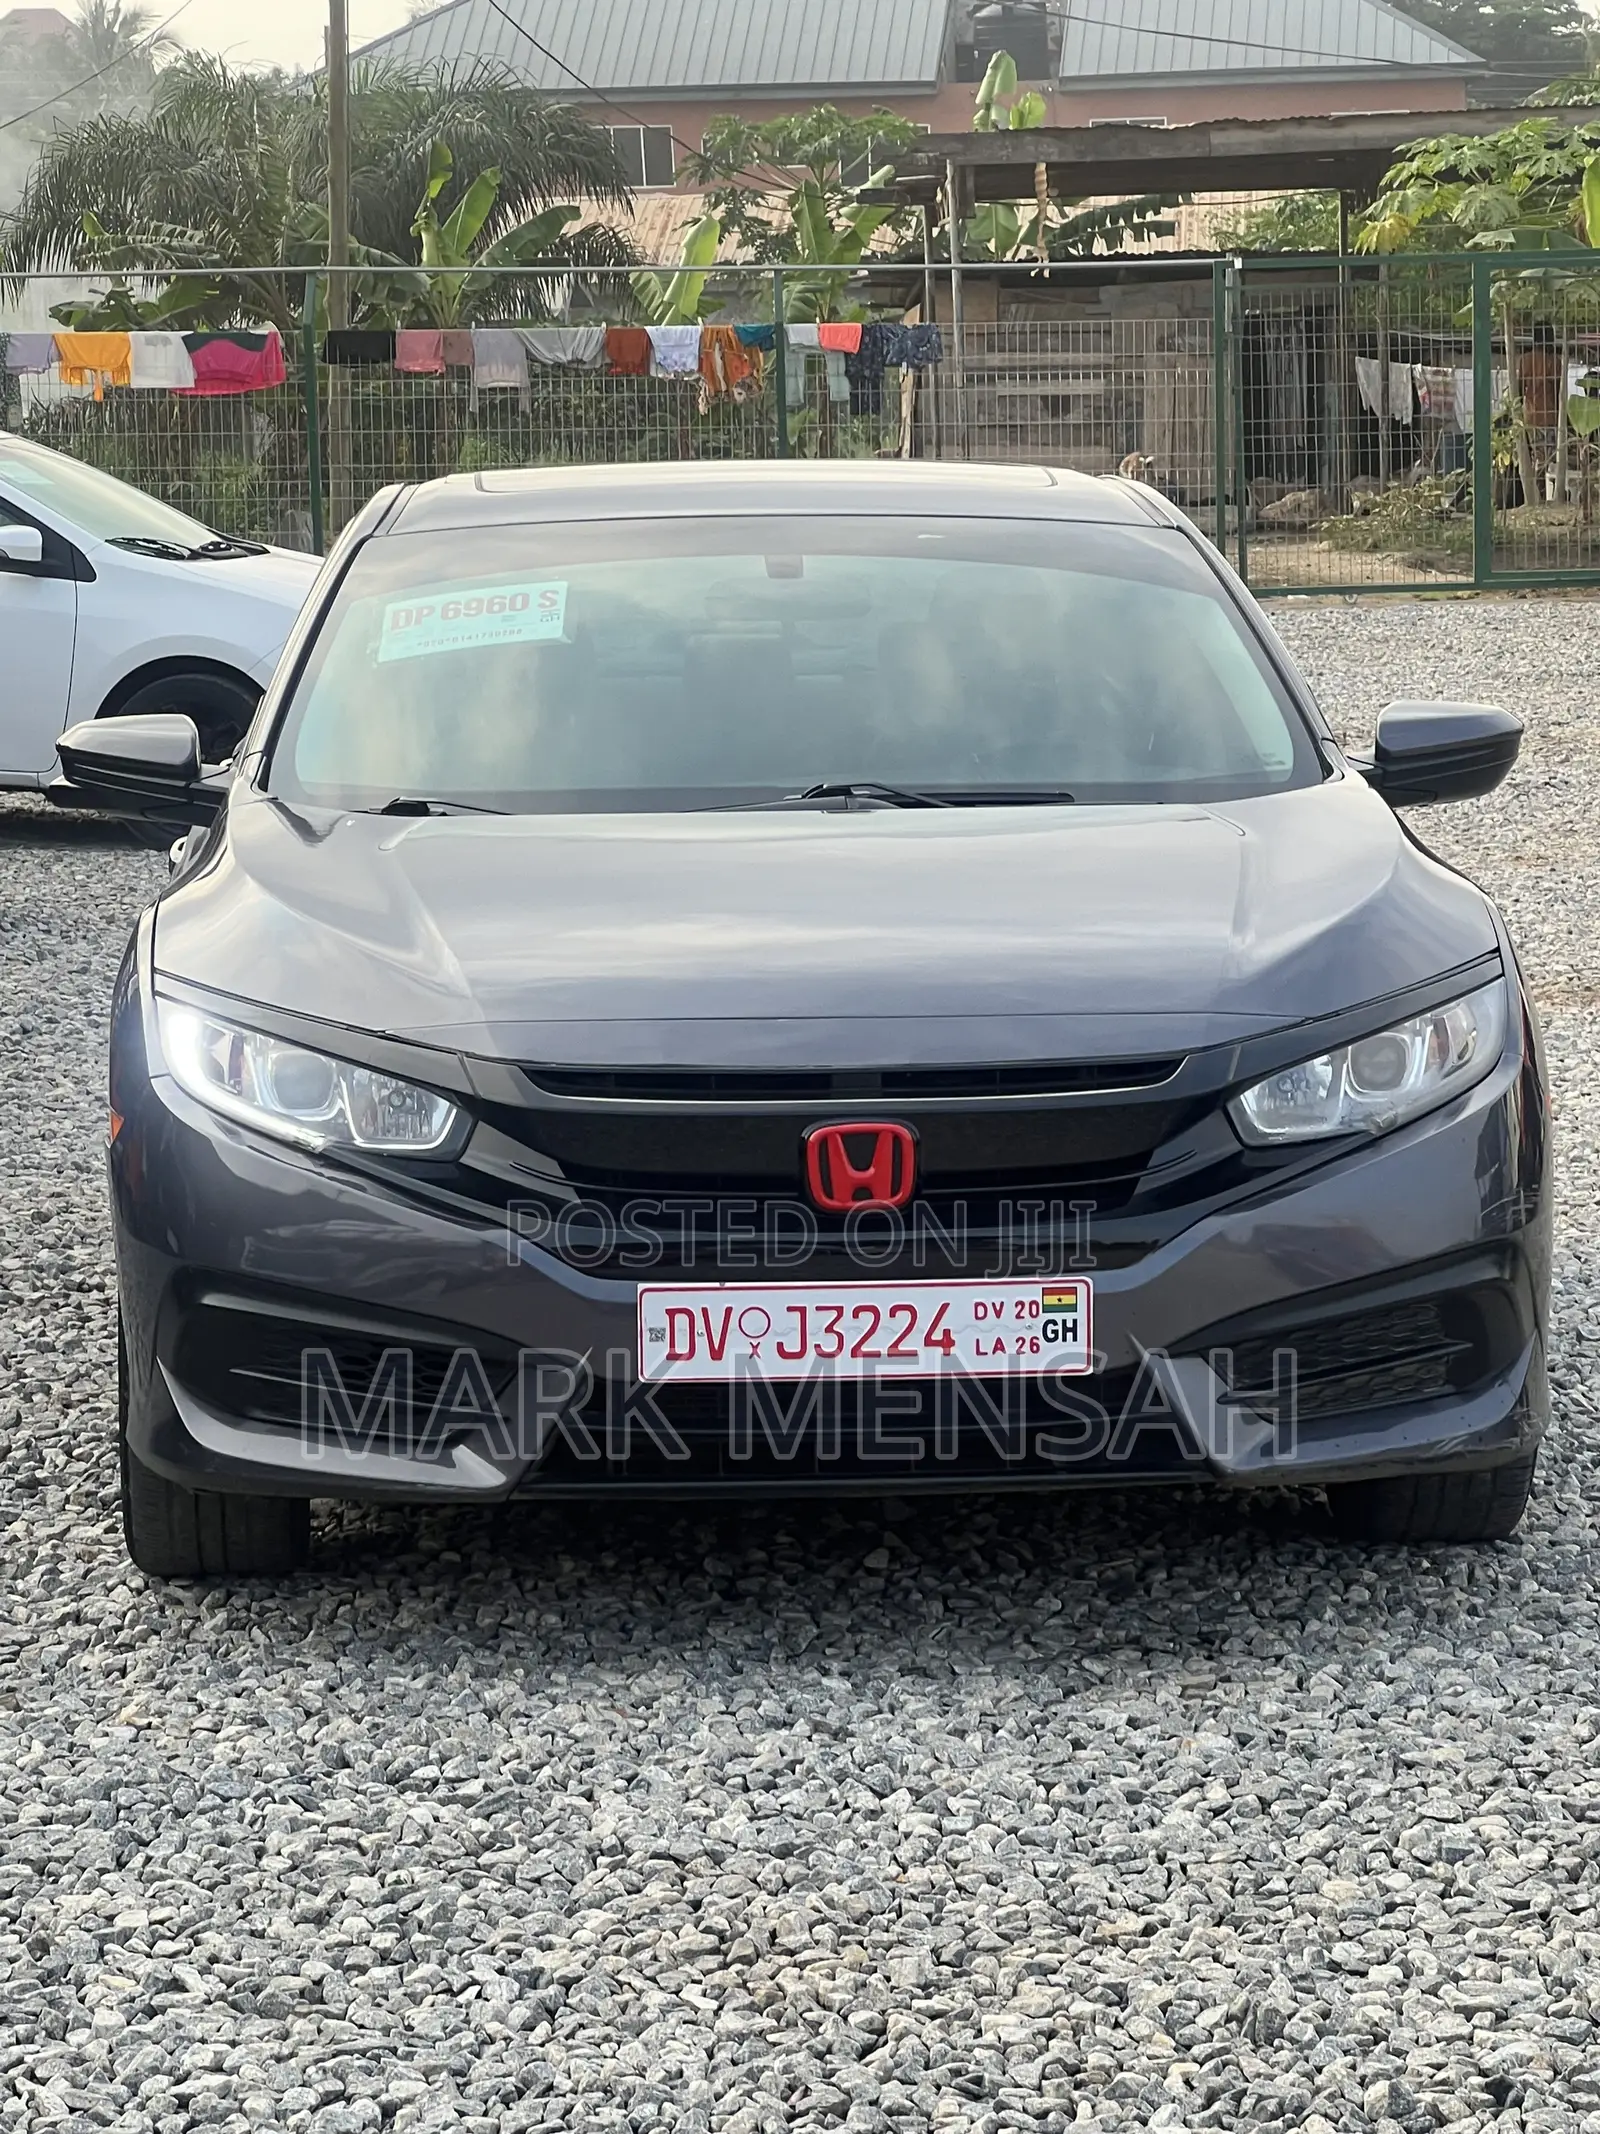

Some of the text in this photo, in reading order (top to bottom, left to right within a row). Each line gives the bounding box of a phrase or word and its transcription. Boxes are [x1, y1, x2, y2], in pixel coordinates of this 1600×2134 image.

[390, 589, 560, 631] DP 6960 S
[974, 1300, 1040, 1321] DV 20
[664, 1306, 734, 1361] DV
[776, 1303, 956, 1361] J3224
[1042, 1318, 1078, 1344] GH
[975, 1335, 1041, 1357] LA 26
